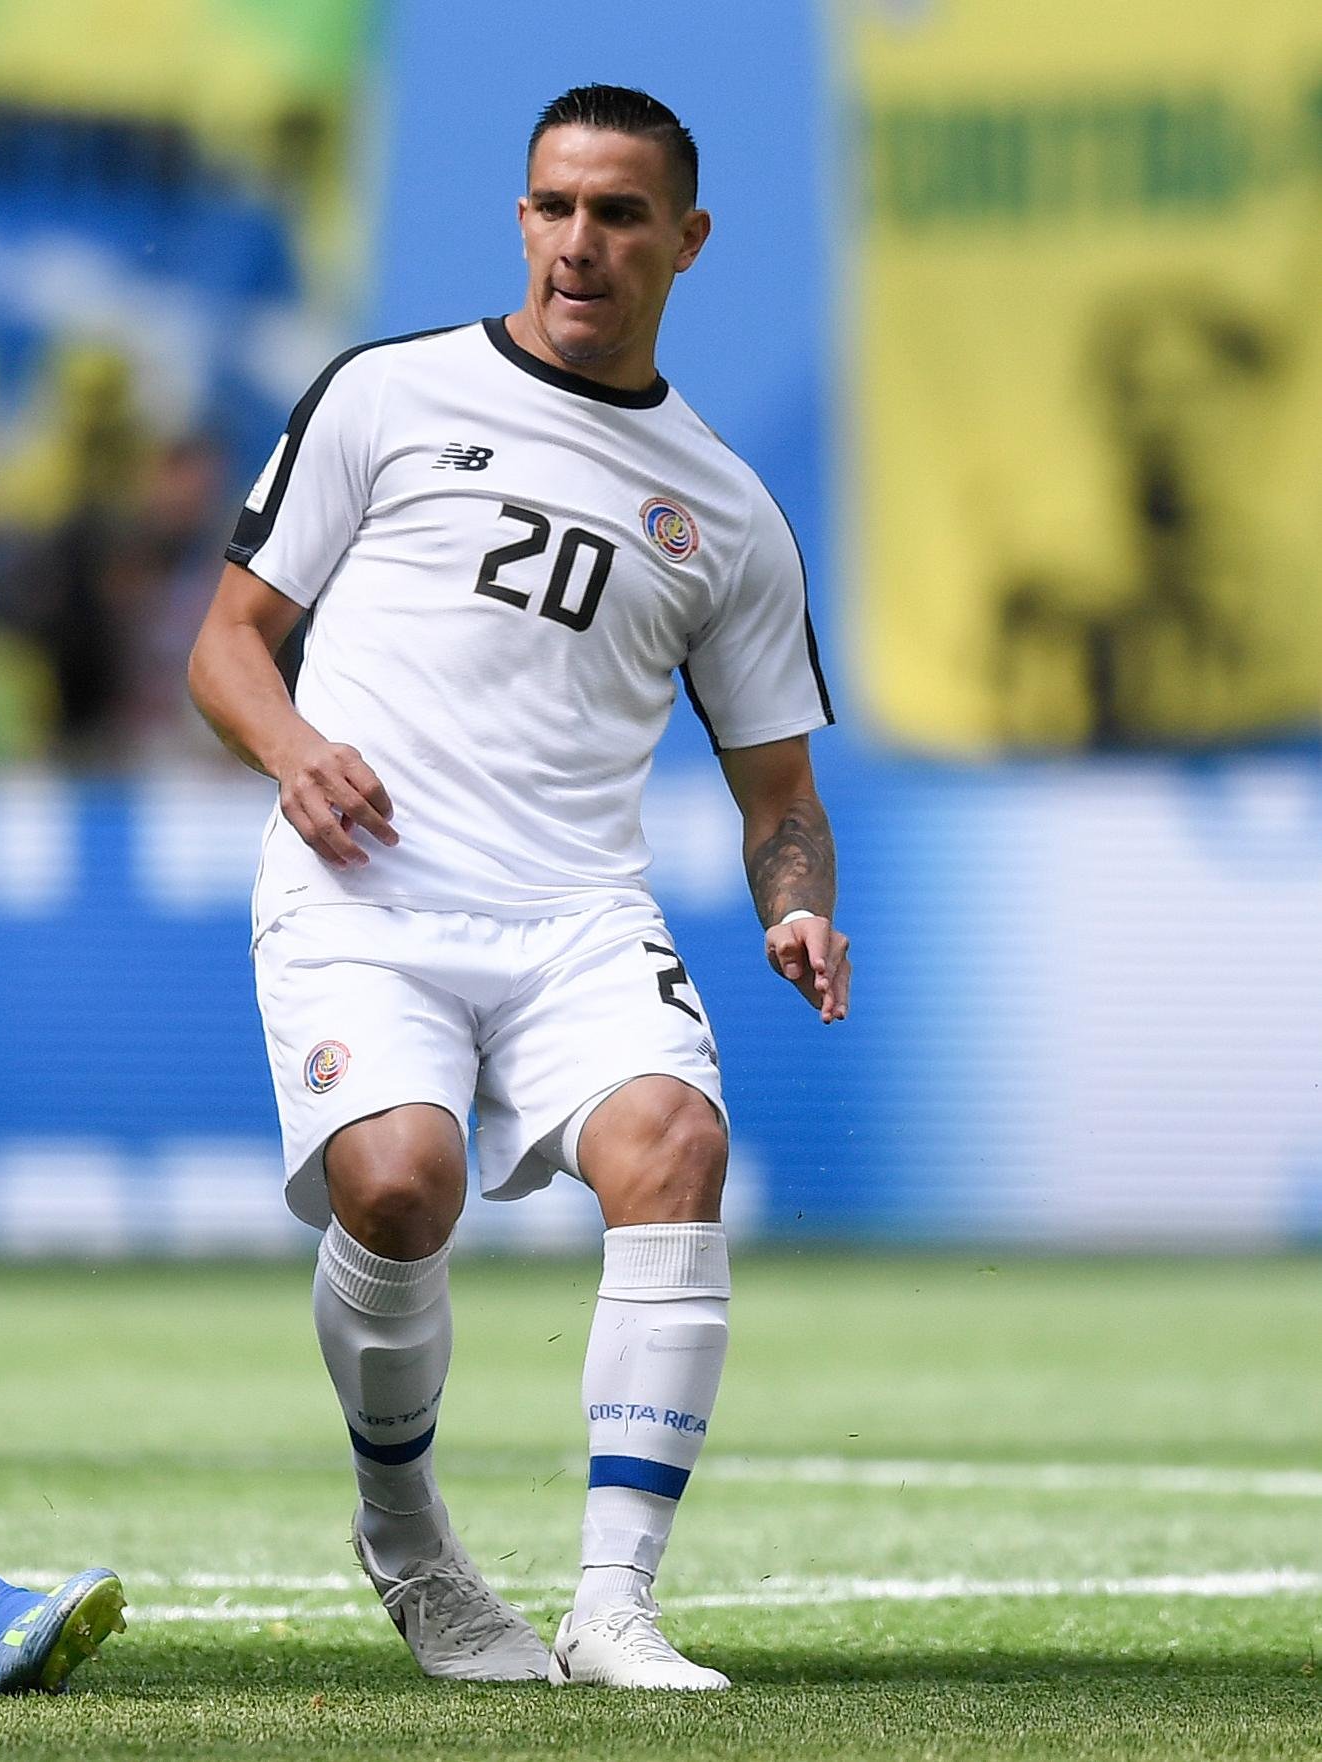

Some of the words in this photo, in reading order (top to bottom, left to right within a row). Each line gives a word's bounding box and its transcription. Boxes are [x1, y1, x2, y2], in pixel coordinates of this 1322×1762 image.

[473, 502, 620, 632] 20
[589, 1404, 657, 1422] COSTA
[663, 1409, 707, 1436] RICA
